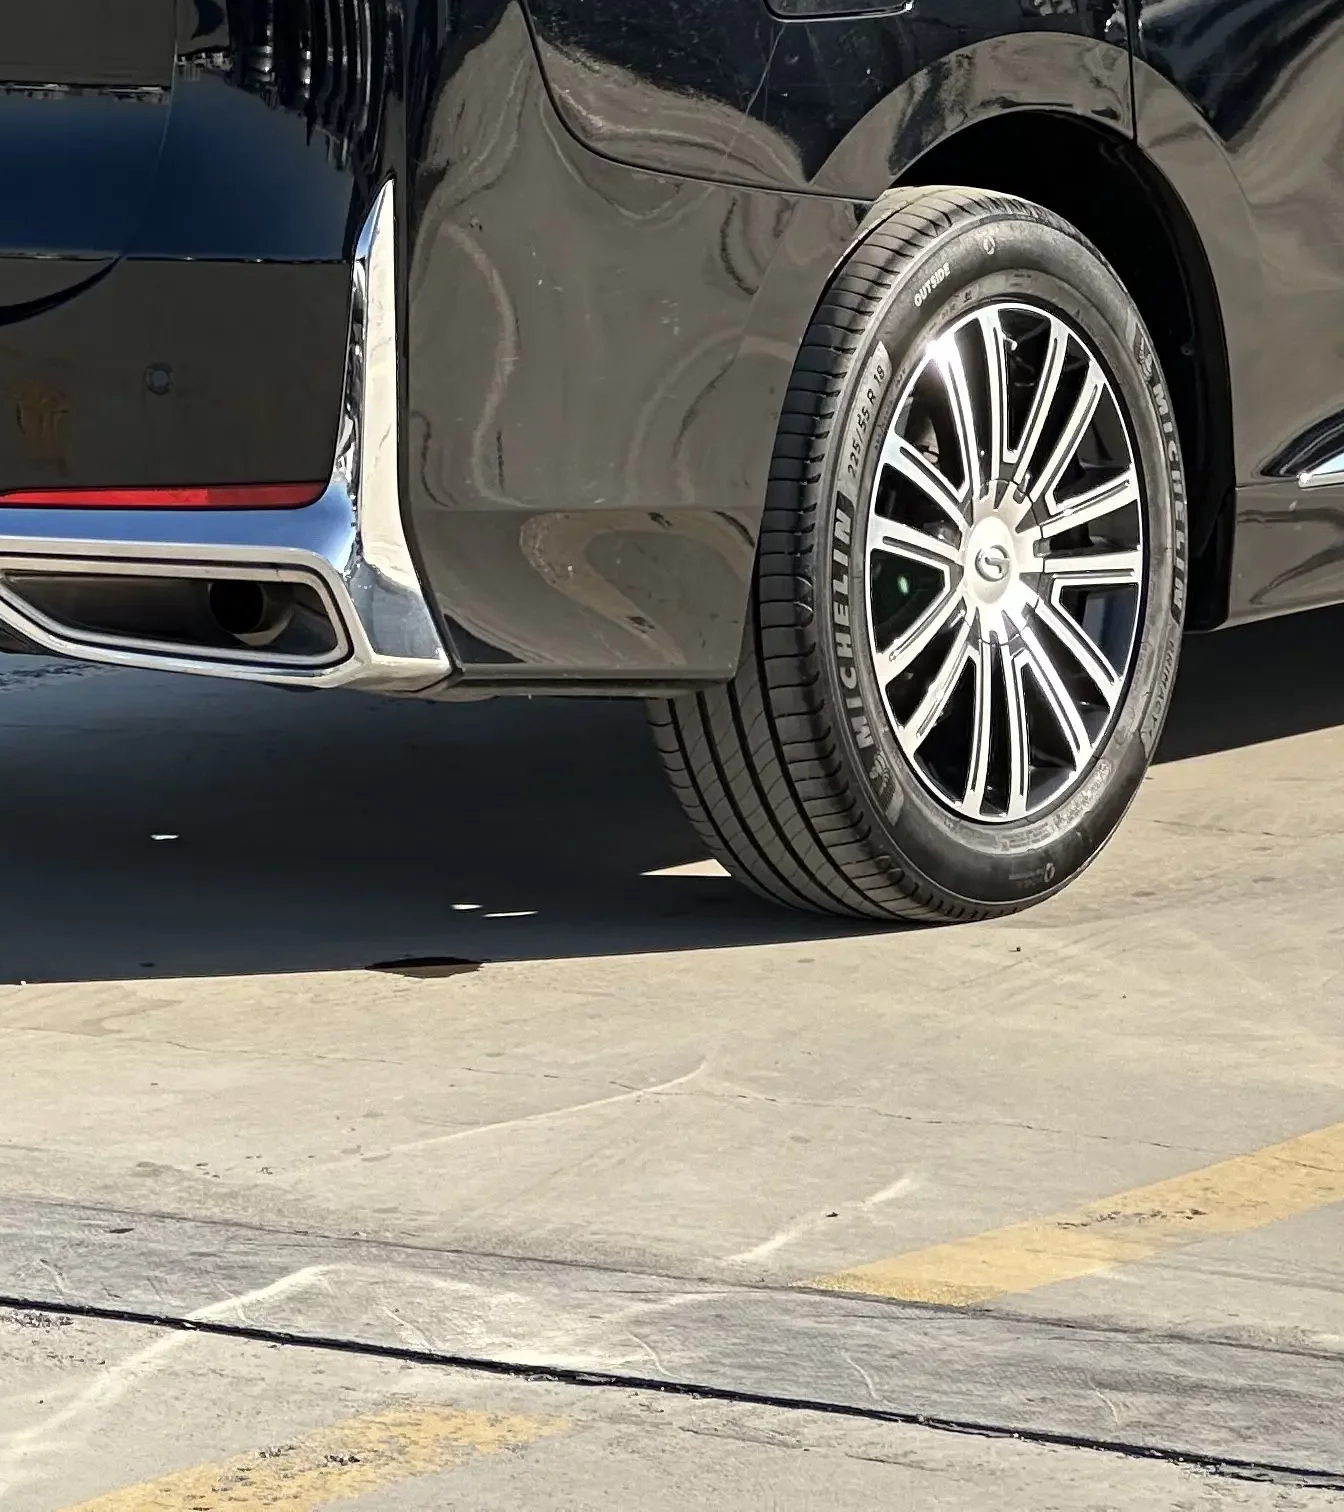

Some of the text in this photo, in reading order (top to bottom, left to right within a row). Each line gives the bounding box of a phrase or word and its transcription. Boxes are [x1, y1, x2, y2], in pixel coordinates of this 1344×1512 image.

[912, 261, 952, 308] OUTSIDE
[847, 406, 871, 480] 225/55
[866, 387, 878, 406] R
[1152, 381, 1189, 610] MICHELIN
[831, 507, 876, 749] MICHELIN
